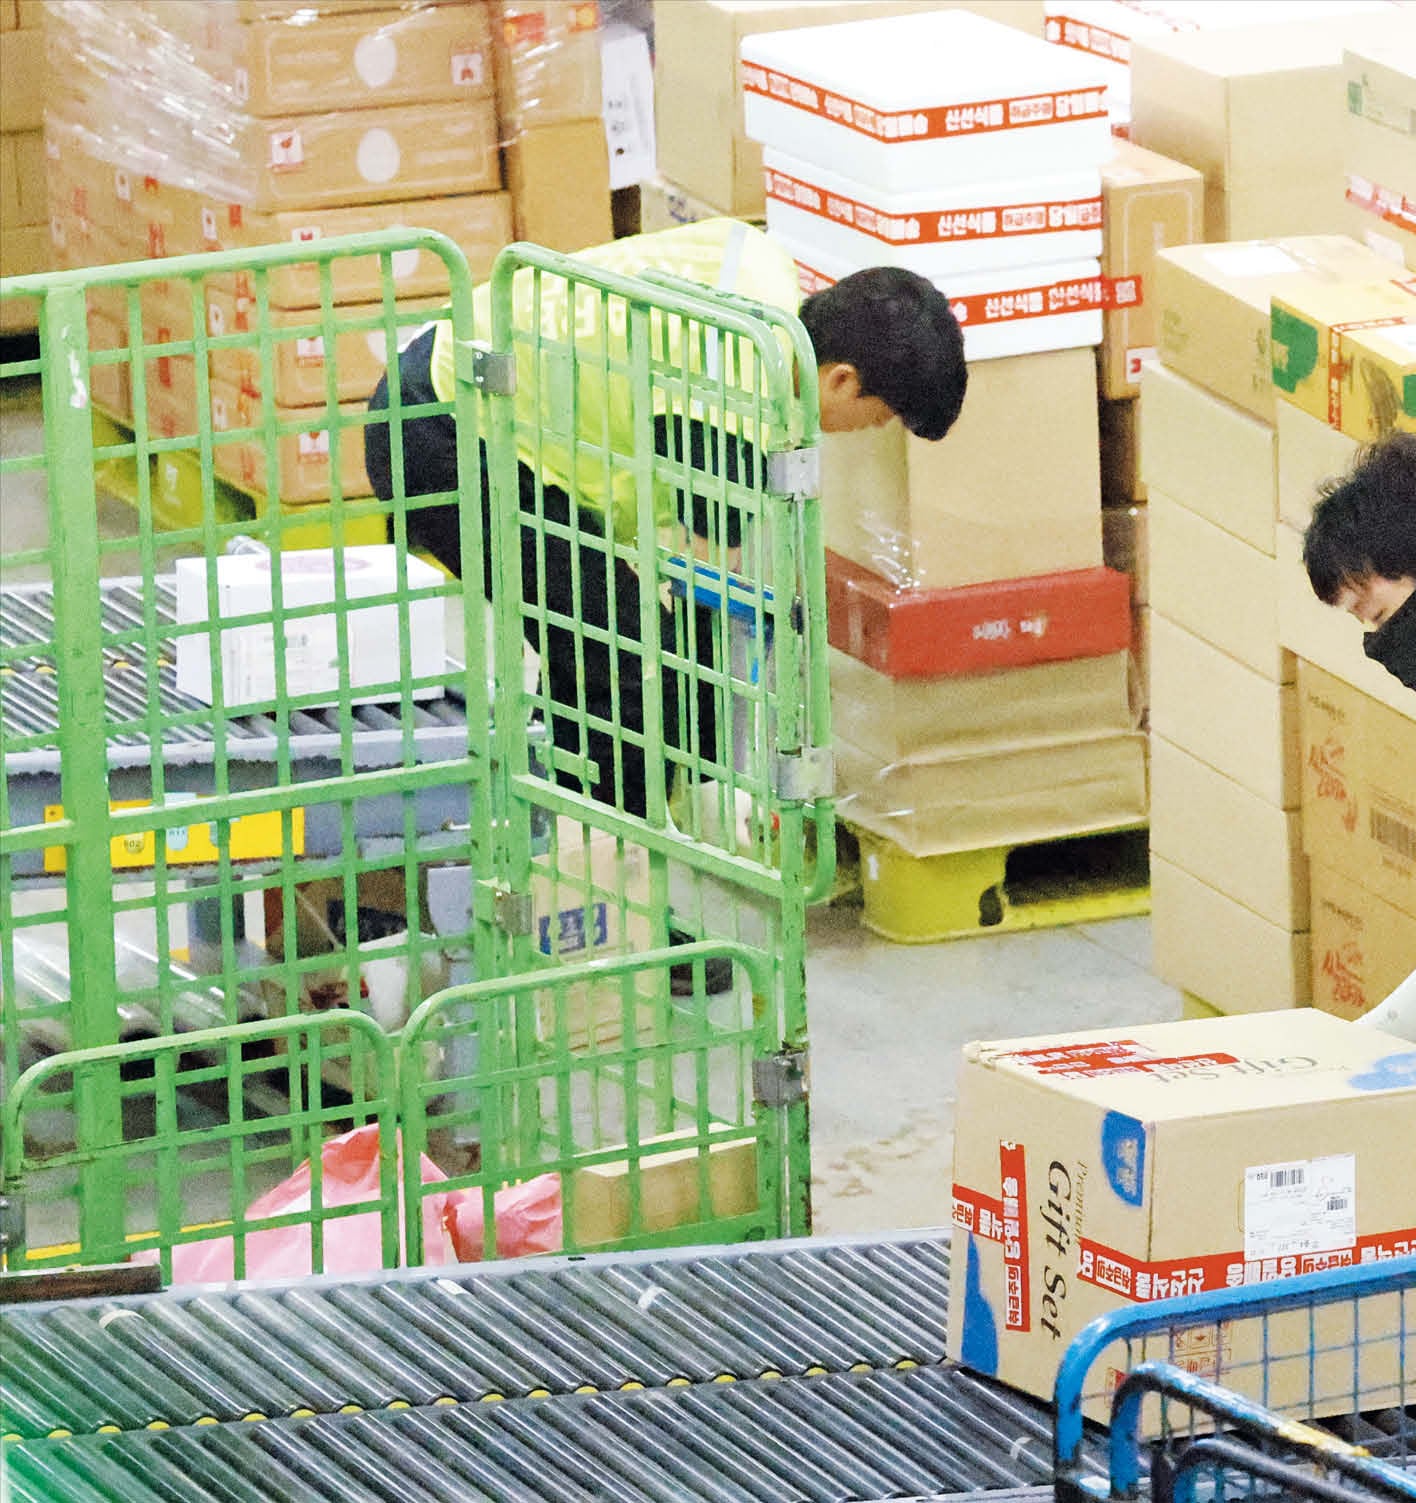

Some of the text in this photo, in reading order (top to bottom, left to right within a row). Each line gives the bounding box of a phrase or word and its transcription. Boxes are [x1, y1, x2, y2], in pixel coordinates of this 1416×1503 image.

[938, 211, 996, 237] 신선식품
[985, 292, 1043, 319] 신선식품
[1073, 1160, 1089, 1245] Premium
[1002, 1177, 1021, 1324] 취급주의 당일배송
[1039, 1160, 1072, 1341] Gift Set
[1136, 1267, 1206, 1300] 신선식품
